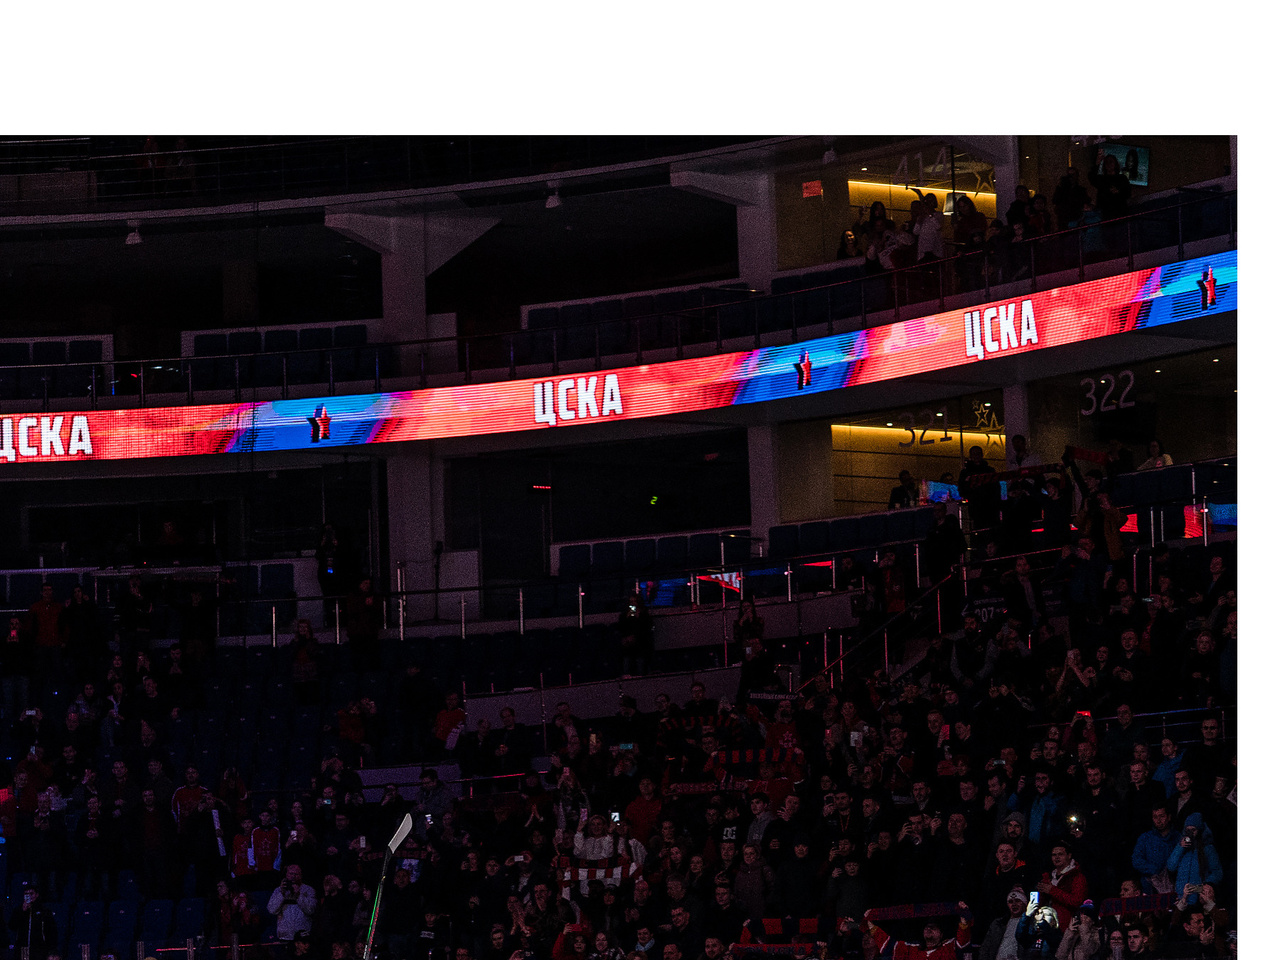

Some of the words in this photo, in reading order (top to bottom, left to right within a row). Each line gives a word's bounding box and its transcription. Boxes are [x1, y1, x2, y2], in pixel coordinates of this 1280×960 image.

[964, 299, 1039, 360] ЦСКА
[532, 374, 623, 428] ЦСКА
[1080, 369, 1136, 416] 322
[898, 405, 953, 448] 321
